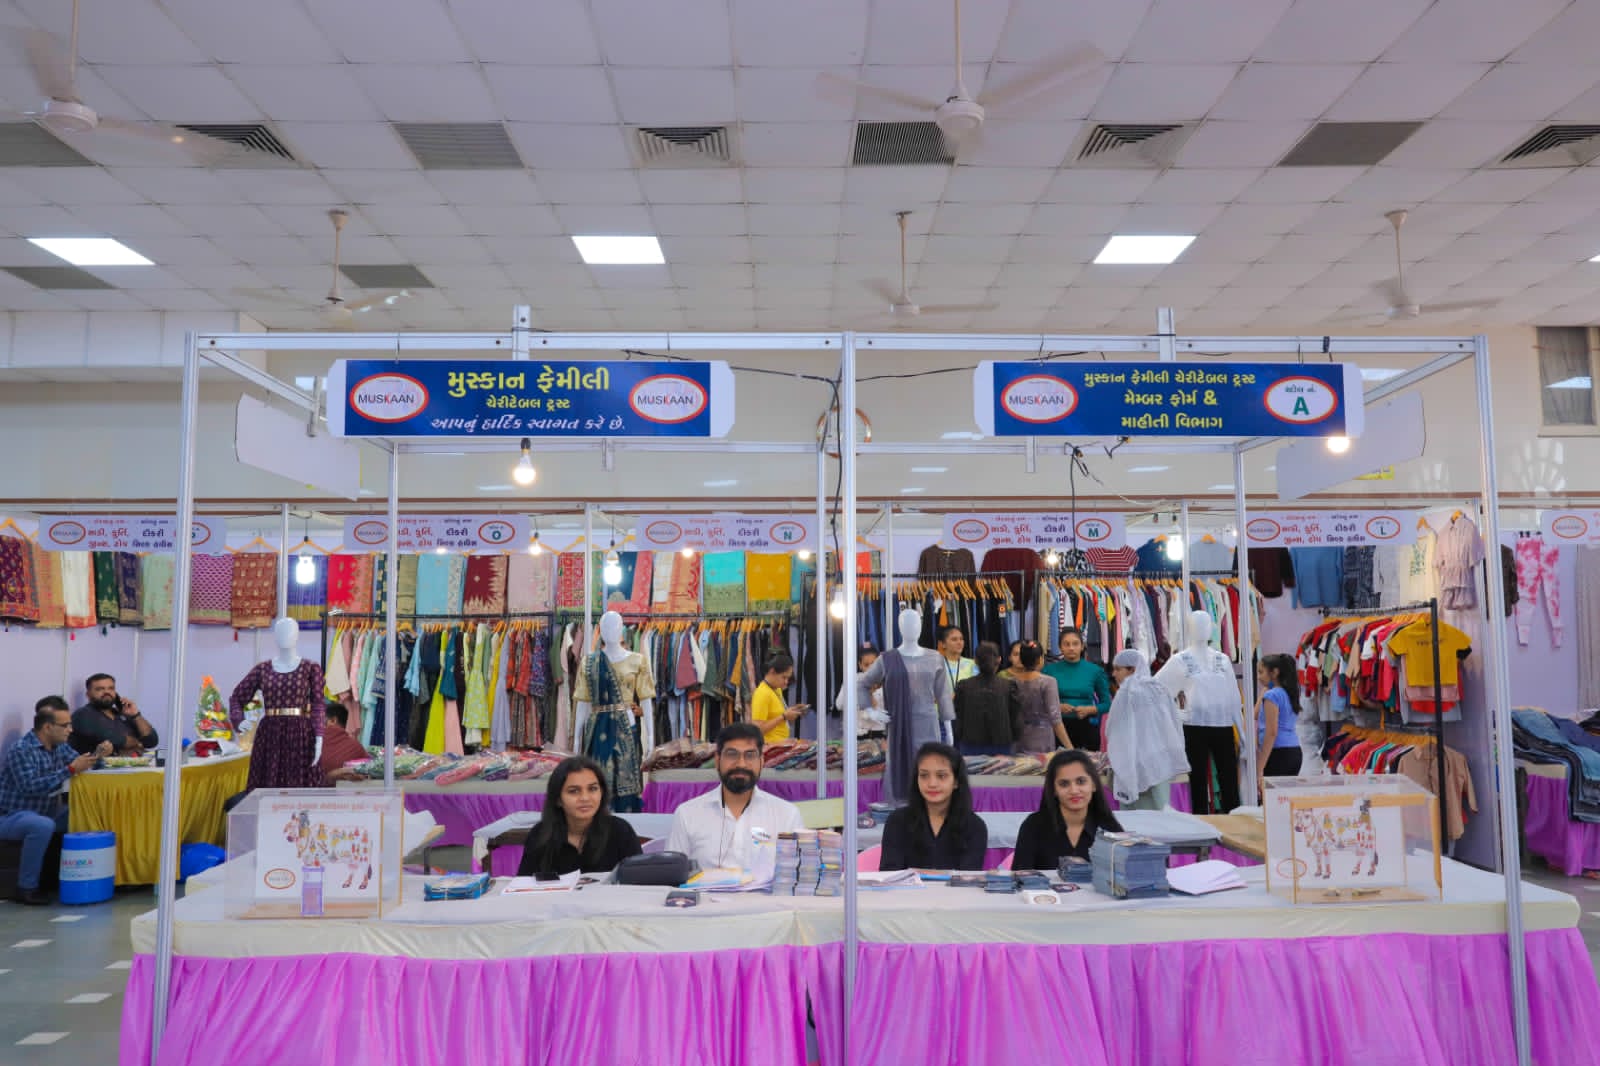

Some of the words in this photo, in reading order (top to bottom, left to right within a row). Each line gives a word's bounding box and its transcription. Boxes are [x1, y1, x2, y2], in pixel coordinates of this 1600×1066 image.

[448, 371, 525, 398] મુસ્કાન
[536, 365, 610, 393] ફેમીલી
[1084, 372, 1125, 387] મુસ્કાન
[1131, 369, 1169, 385] ફેમીલી
[1174, 369, 1228, 384] ચેરીટેબલ
[1233, 374, 1256, 387] ટ્રસ્ટ
[358, 393, 415, 404] MUSKAAN
[485, 394, 541, 409] ચેરીટેબલ
[546, 398, 571, 412] ટ્રસ્ટ
[637, 394, 694, 405] MUSKAAN
[1009, 394, 1065, 405] MUSKAAN
[1124, 389, 1163, 405] મેમ્બર
[1169, 389, 1197, 407] ફોર્મ
[1203, 390, 1218, 405] &
[1292, 396, 1310, 415] A
[431, 414, 479, 433] આપનું
[481, 413, 522, 430] હાર્દિક
[526, 417, 580, 431] સ્વાગત
[584, 415, 604, 430] કરે
[1121, 413, 1169, 428] માહીતી
[1175, 413, 1223, 429] વિભાગ
[492, 530, 501, 540] O
[784, 532, 792, 540] N
[1088, 528, 1099, 537] M
[1380, 526, 1387, 535] L
